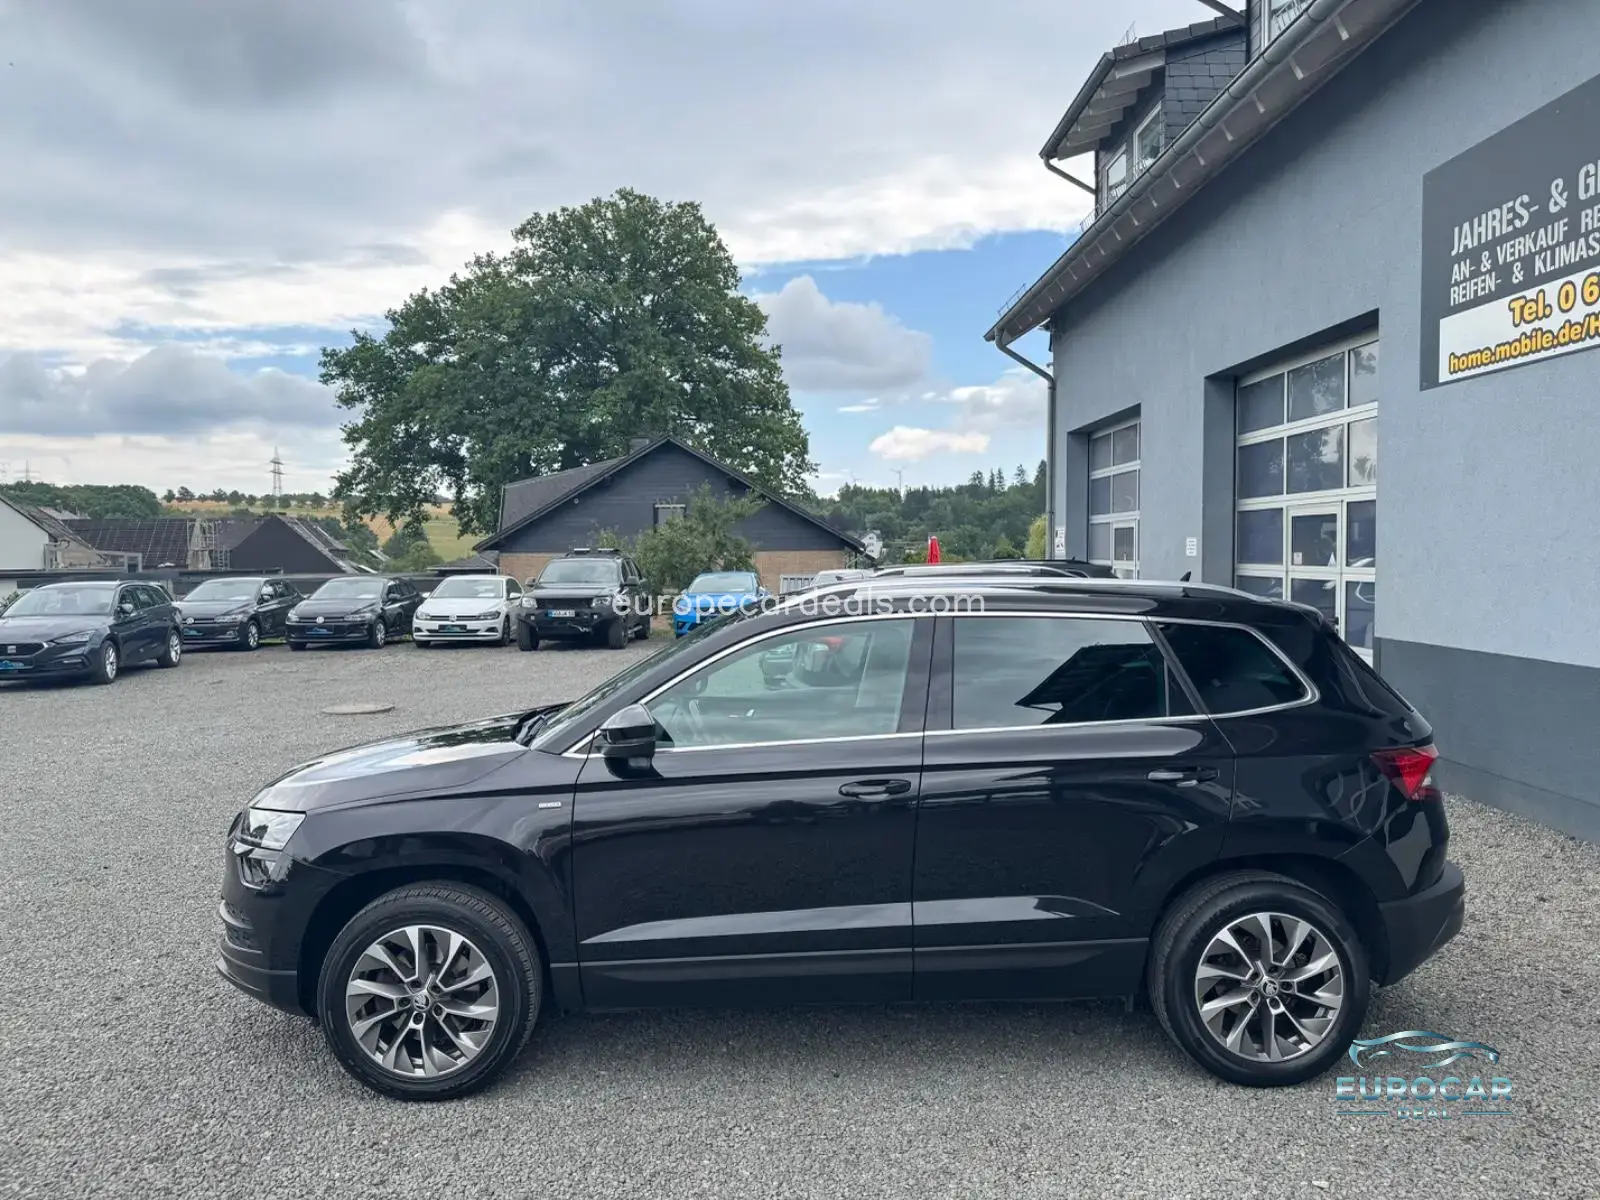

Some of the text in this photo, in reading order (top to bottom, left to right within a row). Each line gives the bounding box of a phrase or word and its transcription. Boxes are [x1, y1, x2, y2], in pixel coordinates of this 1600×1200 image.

[1451, 160, 1600, 256] JAHRES- & G
[1450, 231, 1600, 306] REIFEN- & KLIMAS
[1451, 259, 1476, 284] AN-
[1480, 250, 1491, 272] &
[1497, 217, 1568, 265] VERKAUF
[1508, 288, 1552, 327] Tel.
[1558, 280, 1576, 313] 0
